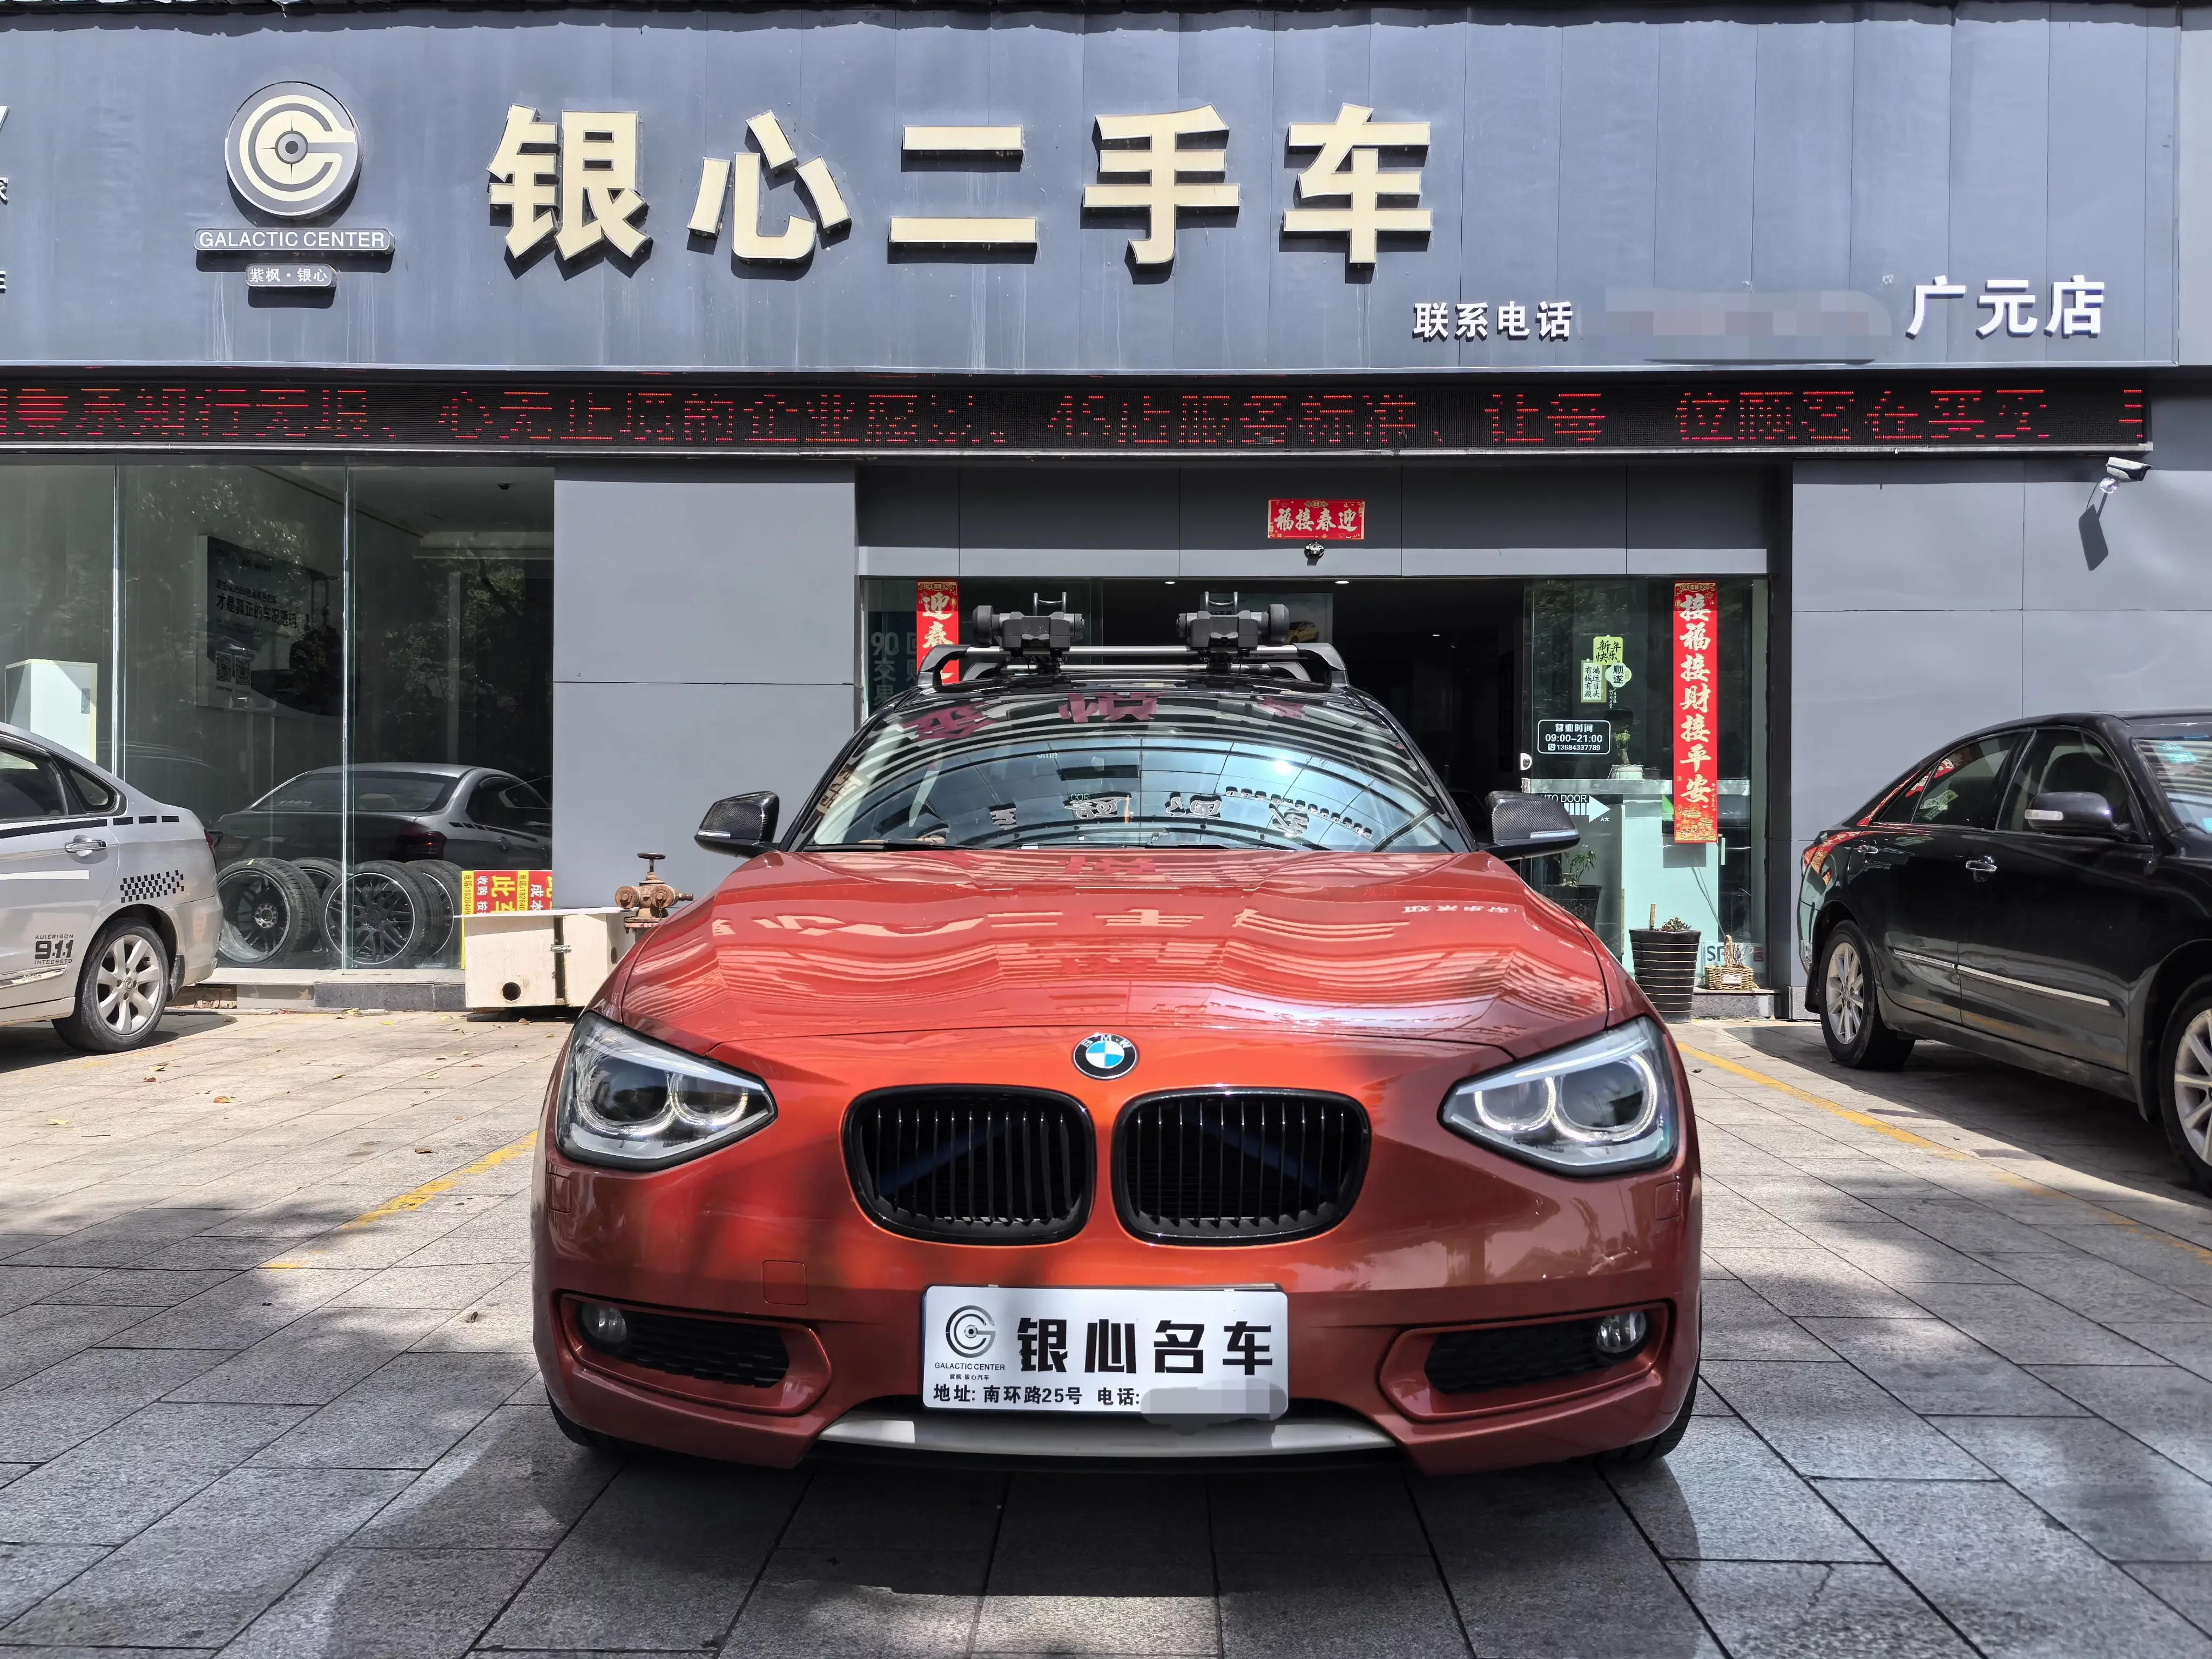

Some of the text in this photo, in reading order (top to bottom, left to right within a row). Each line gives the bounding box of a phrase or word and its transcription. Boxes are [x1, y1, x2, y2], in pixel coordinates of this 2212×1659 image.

[487, 103, 1432, 264] 银心二手车
[199, 232, 385, 247] GALACTIC CENTER
[1905, 274, 2105, 336] 广元店
[1413, 300, 1573, 339] 联系电话
[1597, 639, 1621, 653] 新年
[1596, 650, 1617, 663] 快乐
[1555, 723, 1593, 733] 营业时间
[1561, 794, 1587, 802] DOOR
[1017, 1317, 1273, 1375] 银心名车
[935, 1362, 972, 1370] GALACTIC
